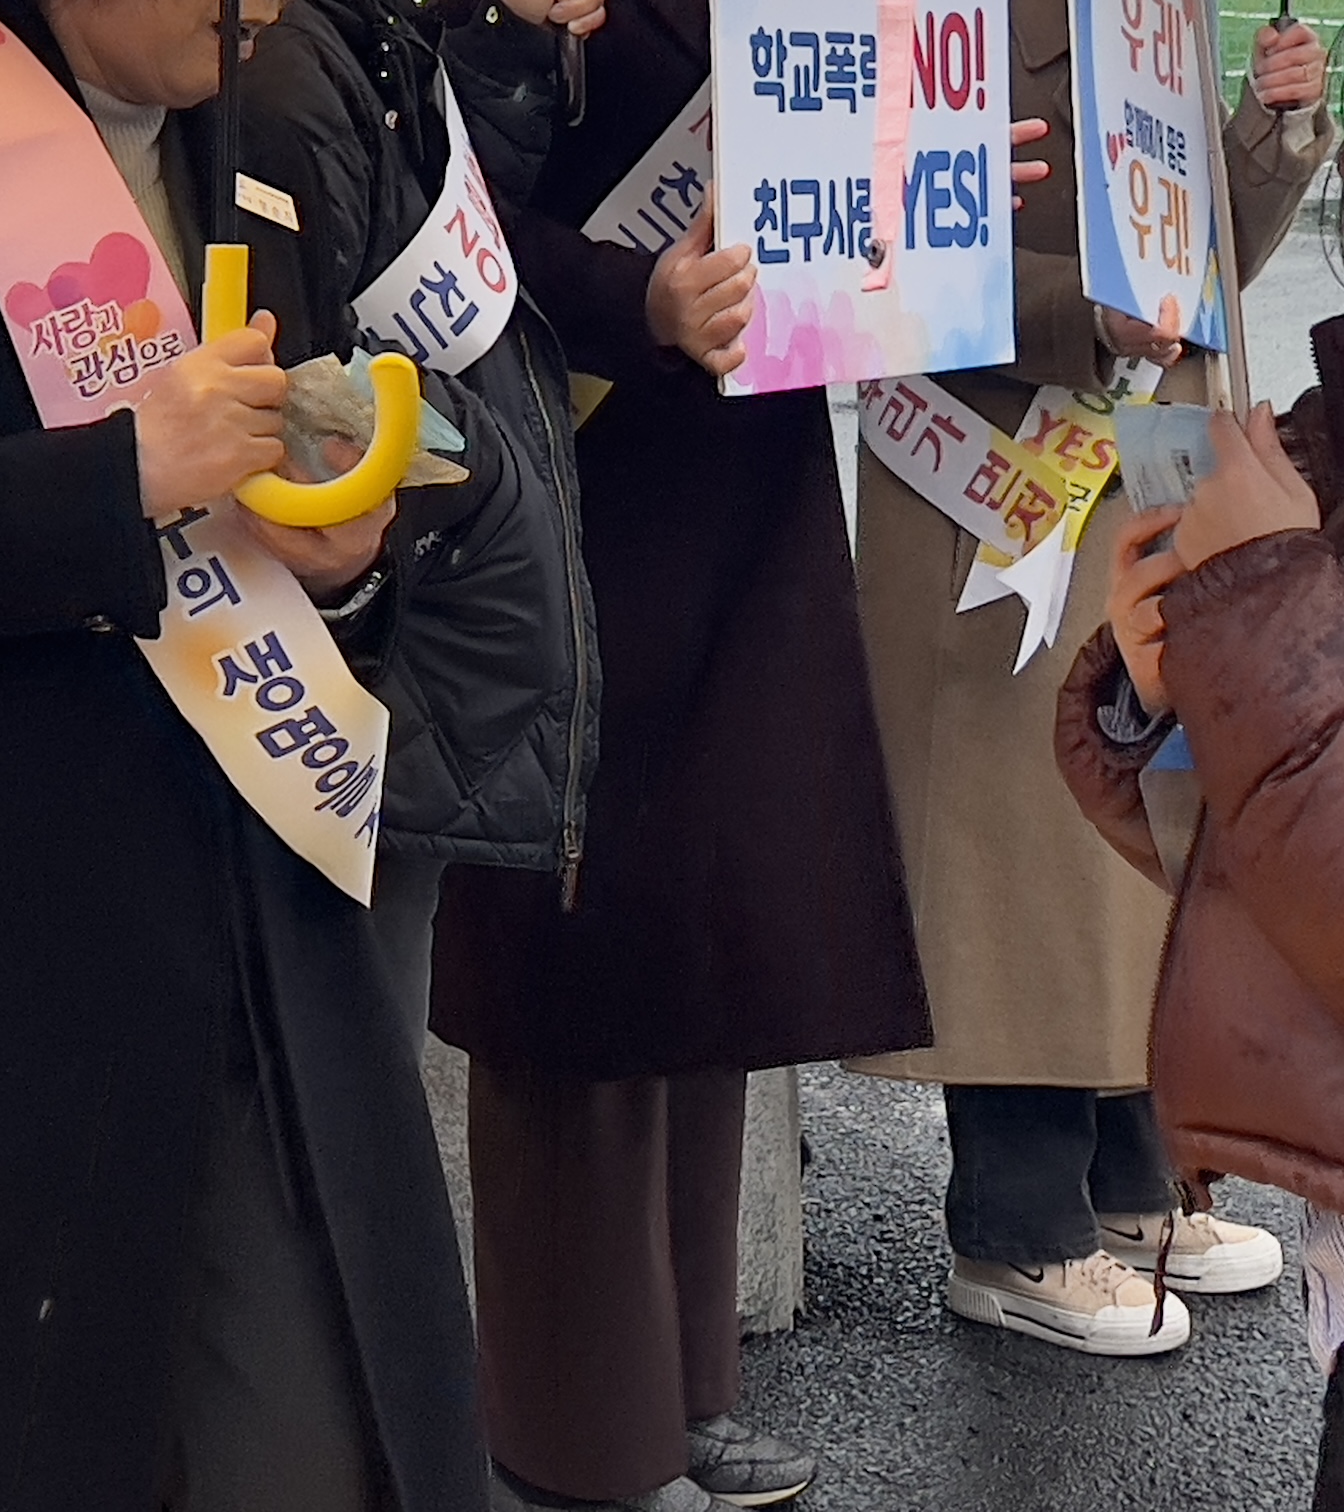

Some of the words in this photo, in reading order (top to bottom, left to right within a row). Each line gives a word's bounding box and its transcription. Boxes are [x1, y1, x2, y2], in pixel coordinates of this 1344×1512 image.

[909, 6, 986, 111] NO!
[902, 143, 989, 250] YES!
[1128, 158, 1194, 277] 우리!
[443, 204, 507, 294] NO
[29, 299, 123, 356] 사랑과
[69, 332, 186, 398] 관심으로
[1028, 408, 1118, 472] YES
[962, 449, 1057, 541] 먼저
[217, 630, 379, 818] 생명을
